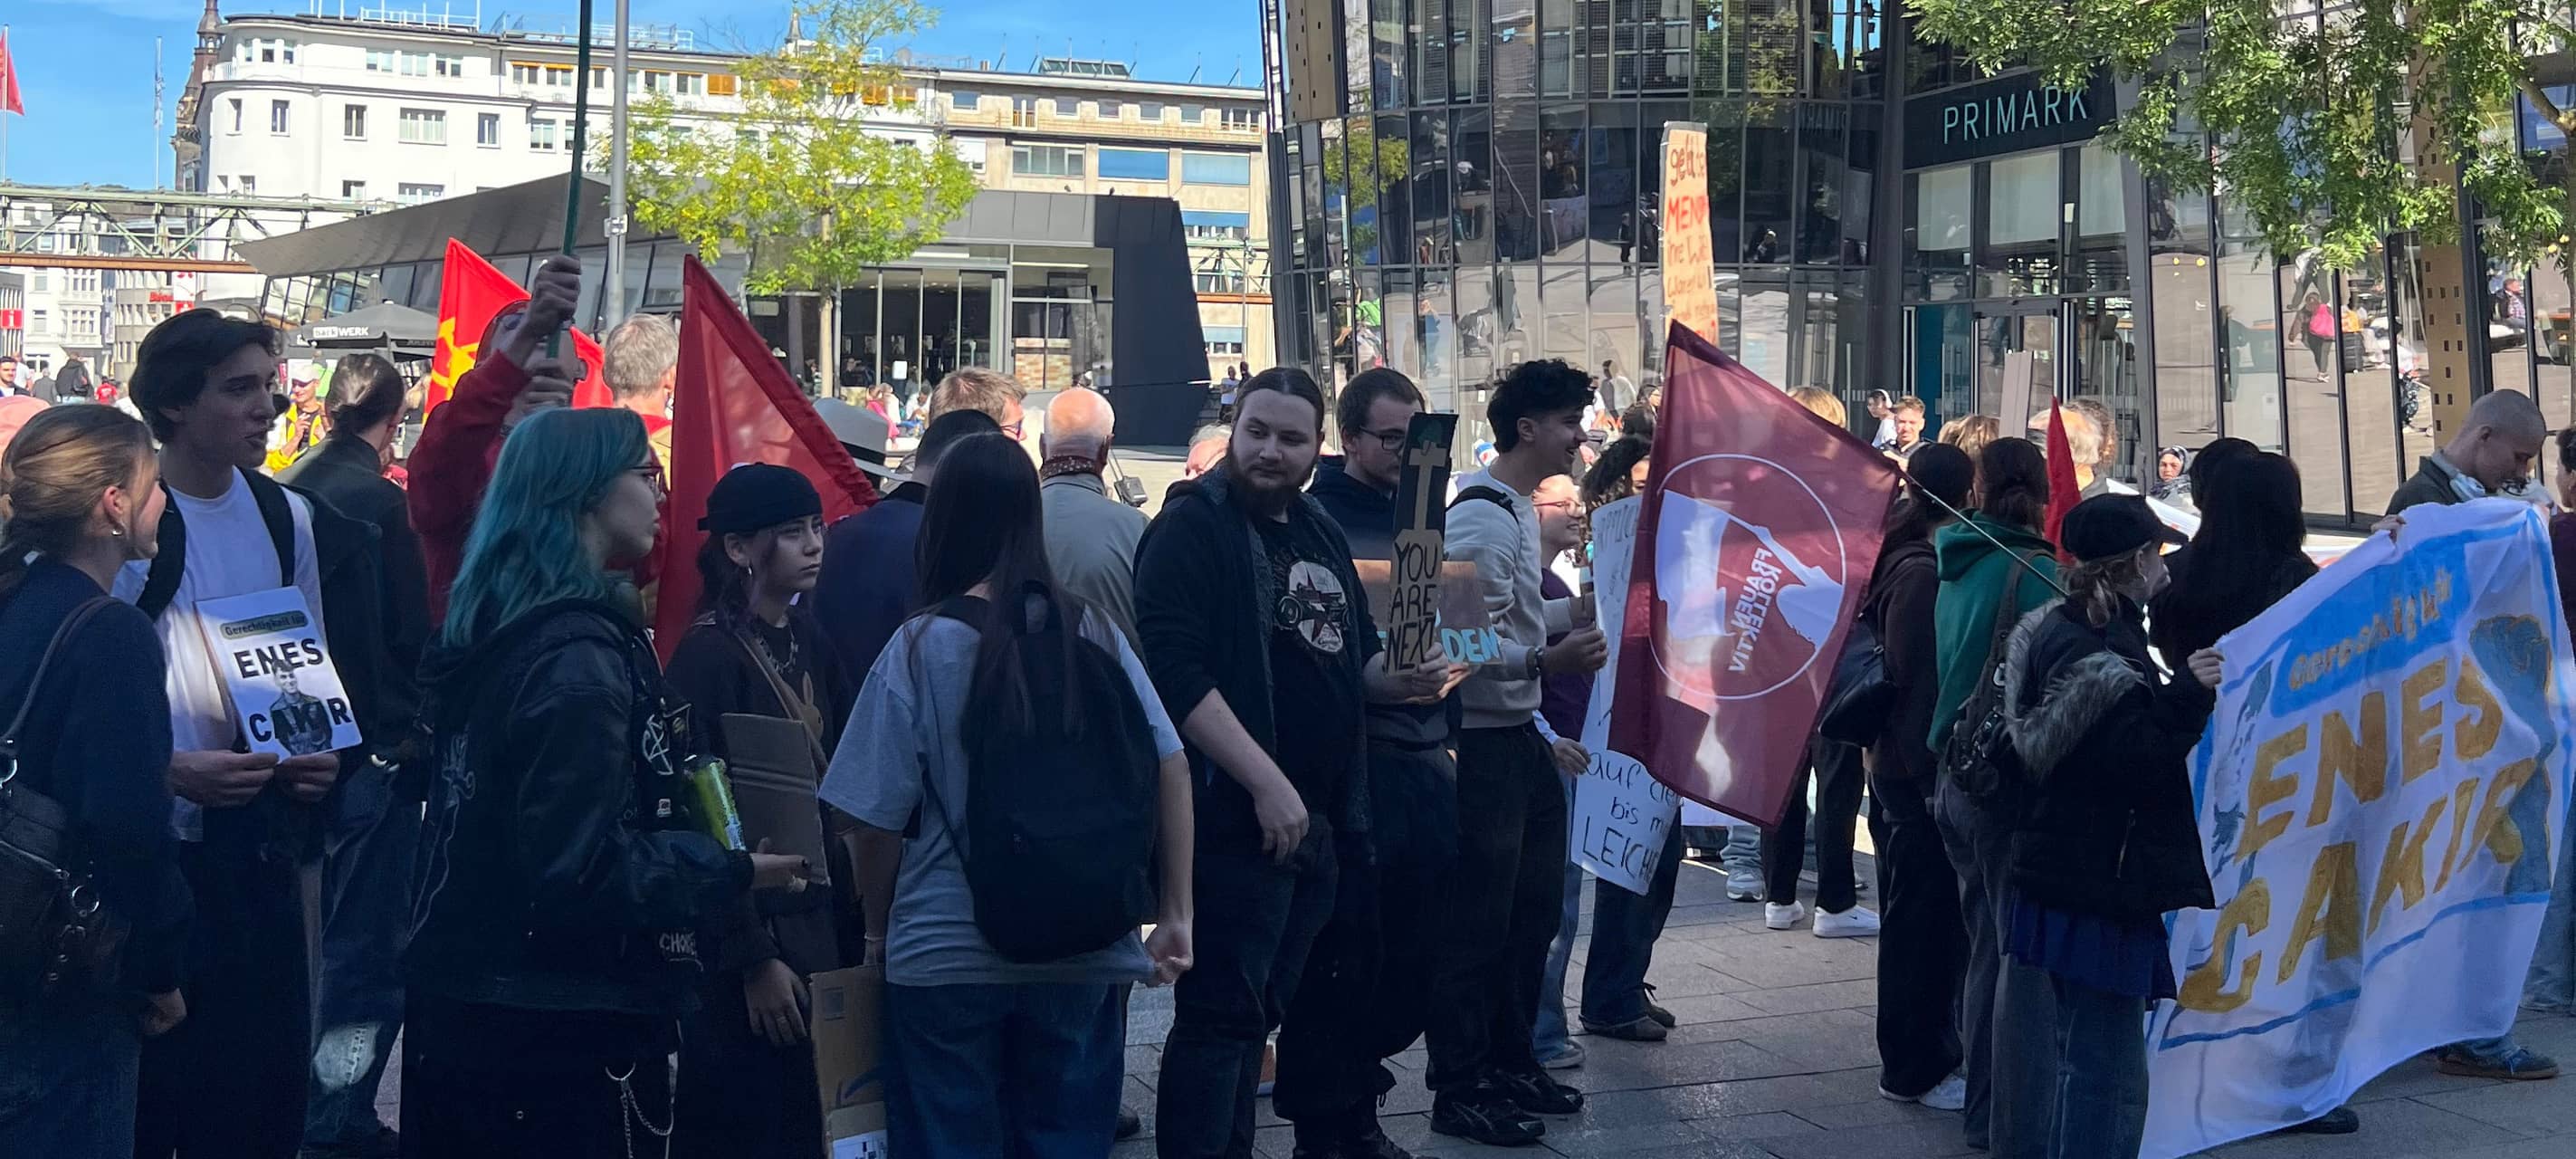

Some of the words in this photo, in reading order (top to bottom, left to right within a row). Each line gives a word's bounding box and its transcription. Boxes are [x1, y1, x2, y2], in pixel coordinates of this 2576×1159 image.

[1943, 85, 2087, 144] PRIMARK
[1394, 541, 1438, 584] YOU
[1390, 584, 1437, 624] ARE
[233, 637, 324, 679] ENES
[1585, 752, 1640, 790] auf
[2234, 655, 2504, 866] ENES
[1610, 796, 1639, 825] bis
